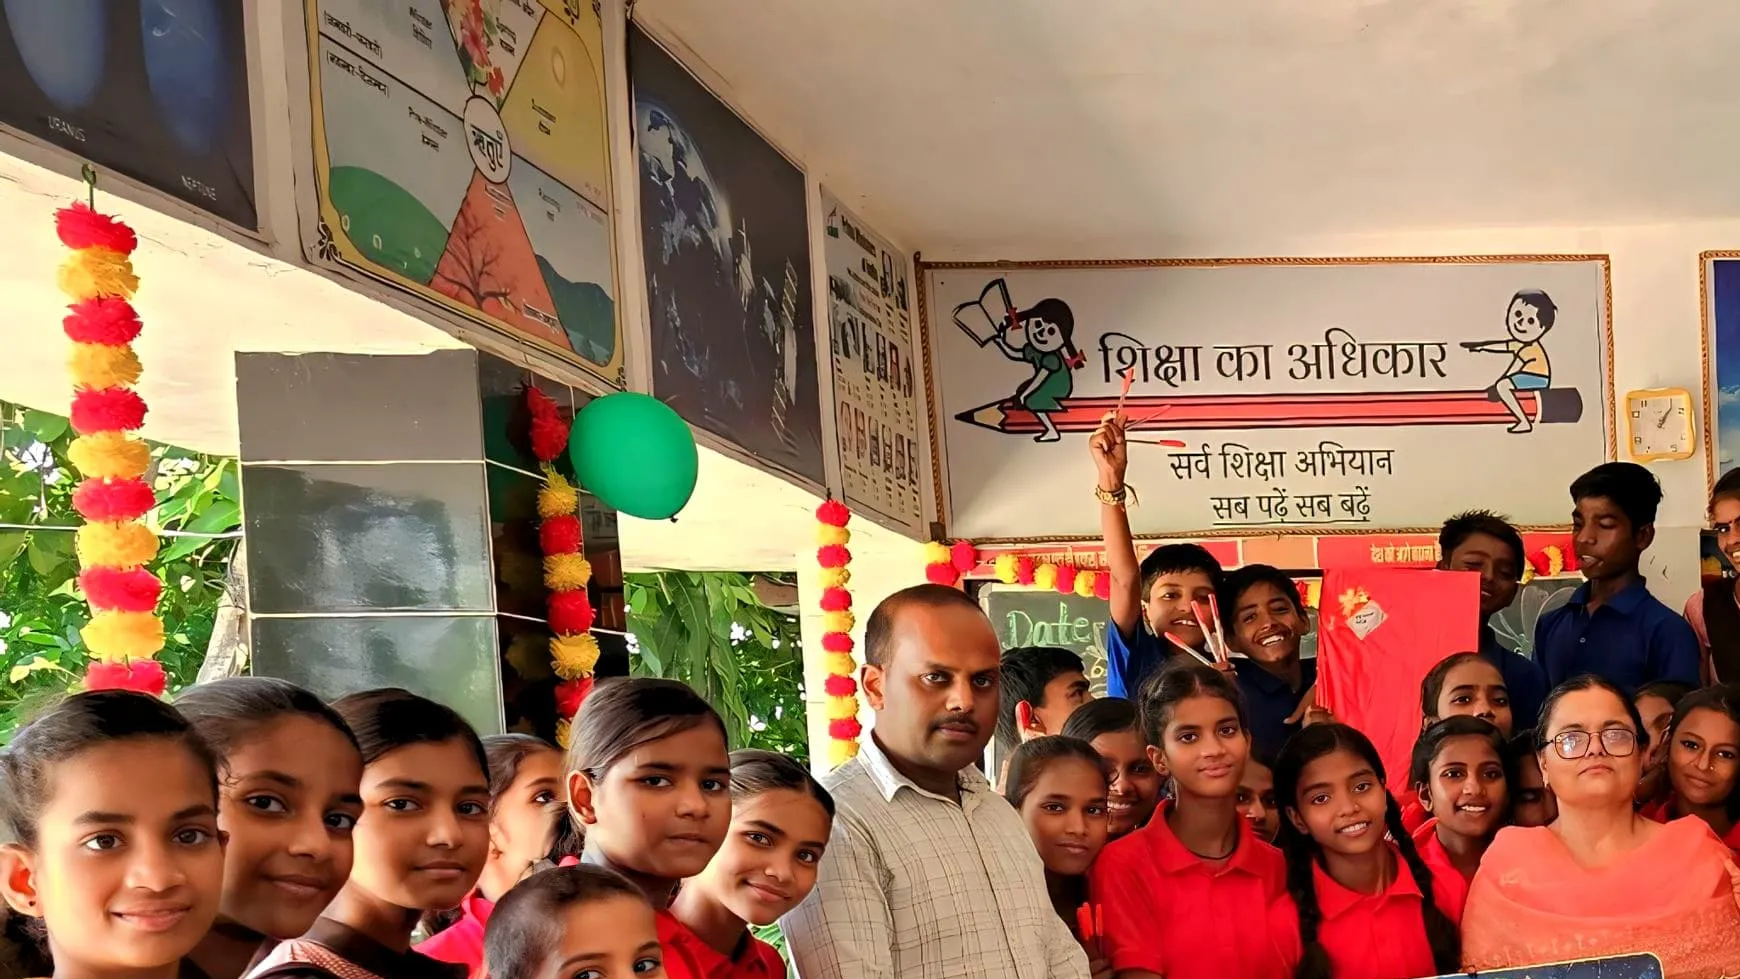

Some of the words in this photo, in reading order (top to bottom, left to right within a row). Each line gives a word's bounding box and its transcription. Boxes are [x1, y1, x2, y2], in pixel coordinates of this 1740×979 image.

[1098, 331, 1203, 388] शिक्षा
[1213, 344, 1273, 381] का
[1287, 327, 1448, 380] अधिकार
[1168, 443, 1212, 480] सर्व
[1218, 442, 1287, 481] शिक्षा
[1295, 441, 1395, 476] अभियान
[1210, 496, 1251, 520] सब
[1255, 488, 1288, 522] पढ़ें
[1294, 494, 1333, 518] सब
[1338, 486, 1371, 521] बढ़ें
[1002, 601, 1091, 650] Date
